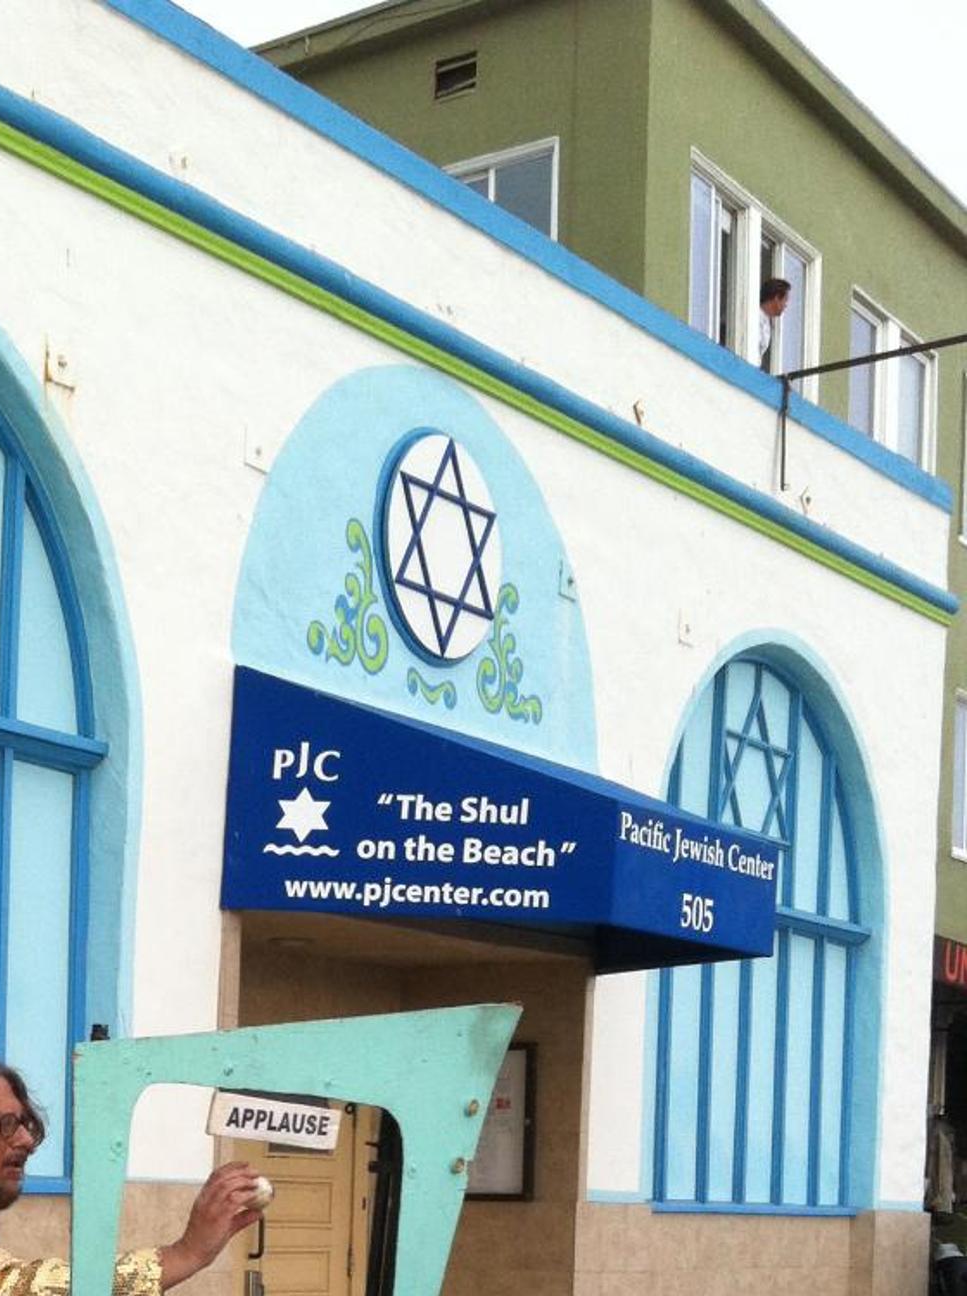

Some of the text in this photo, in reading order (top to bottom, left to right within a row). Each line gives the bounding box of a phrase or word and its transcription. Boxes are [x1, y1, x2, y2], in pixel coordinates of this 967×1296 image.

[272, 741, 341, 782] PJC
[460, 796, 530, 826] Shul
[357, 839, 397, 862] on
[404, 837, 457, 863] the
[620, 811, 774, 881] Pacific Jewish Center
[285, 877, 550, 910] www.pjcenter.com
[681, 894, 714, 932] 505
[226, 1107, 330, 1136] APPLAUSE
